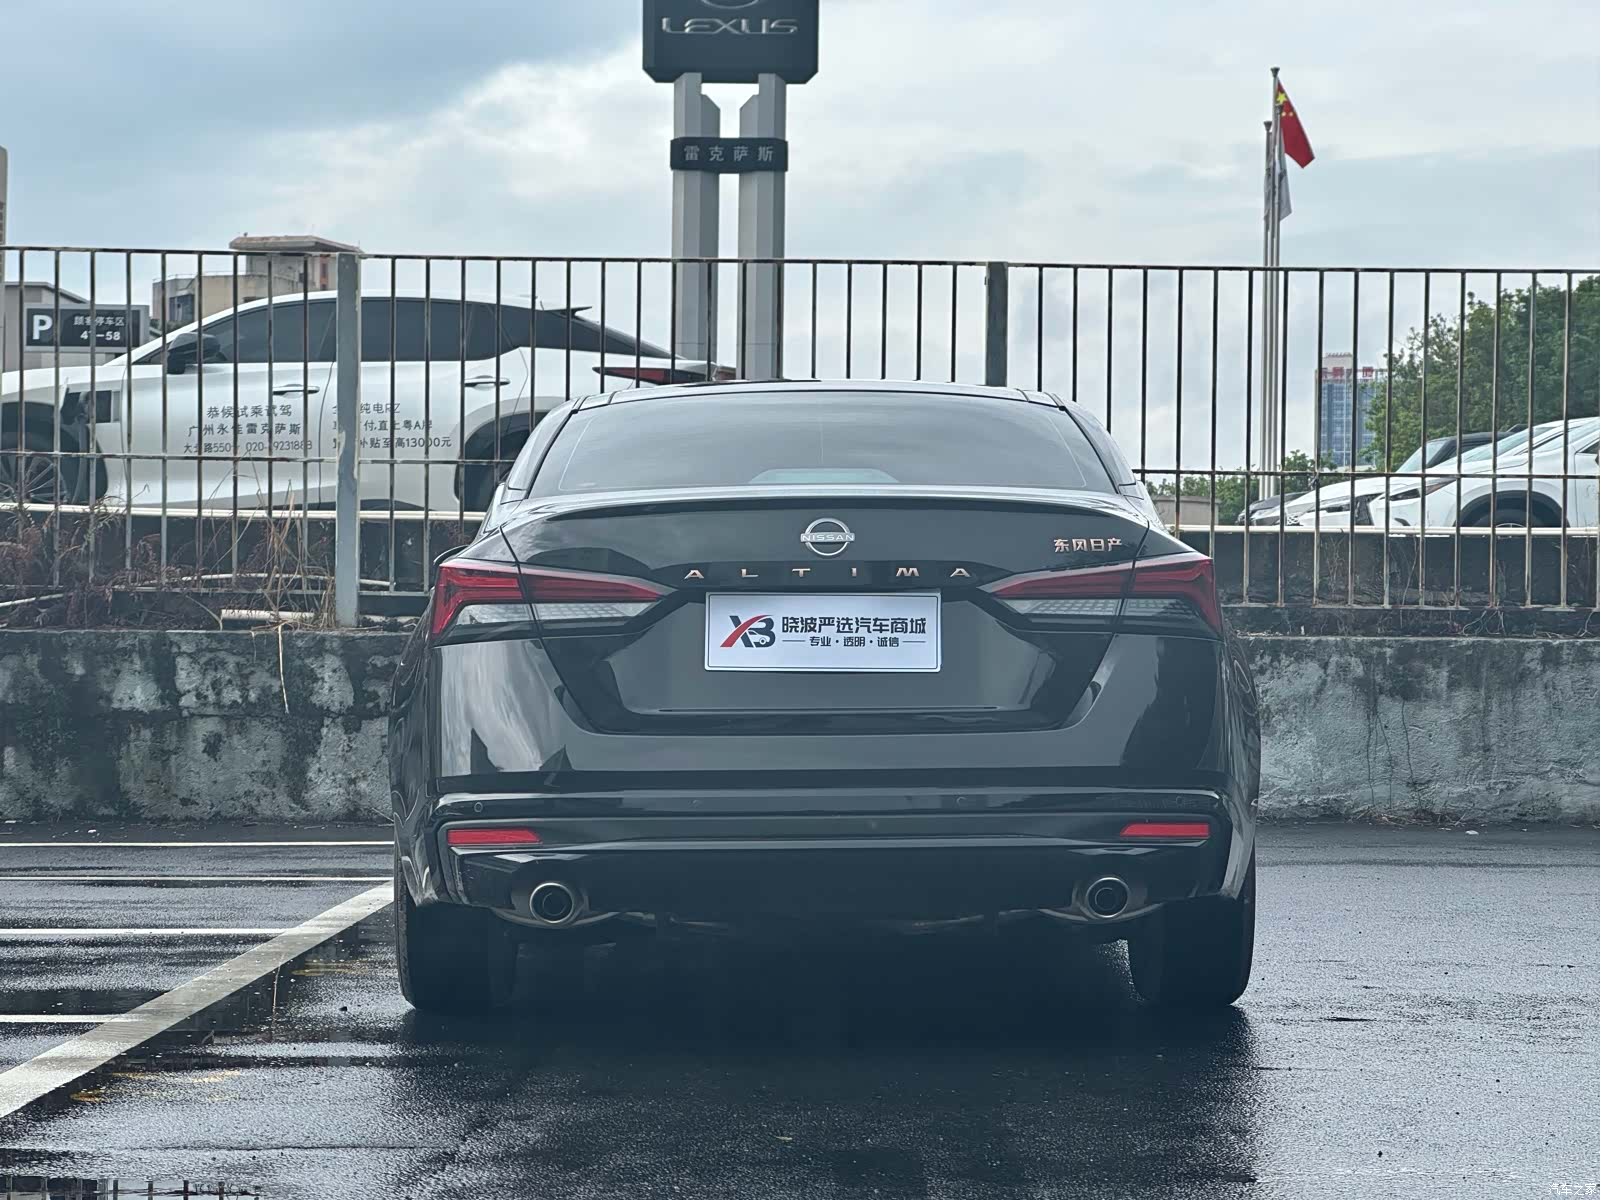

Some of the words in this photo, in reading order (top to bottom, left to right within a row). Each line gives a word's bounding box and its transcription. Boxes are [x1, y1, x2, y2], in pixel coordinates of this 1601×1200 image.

[662, 17, 798, 35] LEXUS
[684, 145, 773, 161] 雷克萨斯
[32, 314, 53, 340] P
[207, 404, 292, 419] 恭候试乘试驾
[802, 533, 855, 542] NISSAN
[1053, 537, 1123, 553] 东风日产
[684, 567, 971, 580] ALTIMA
[781, 616, 927, 634] 晓波严选汽车商城
